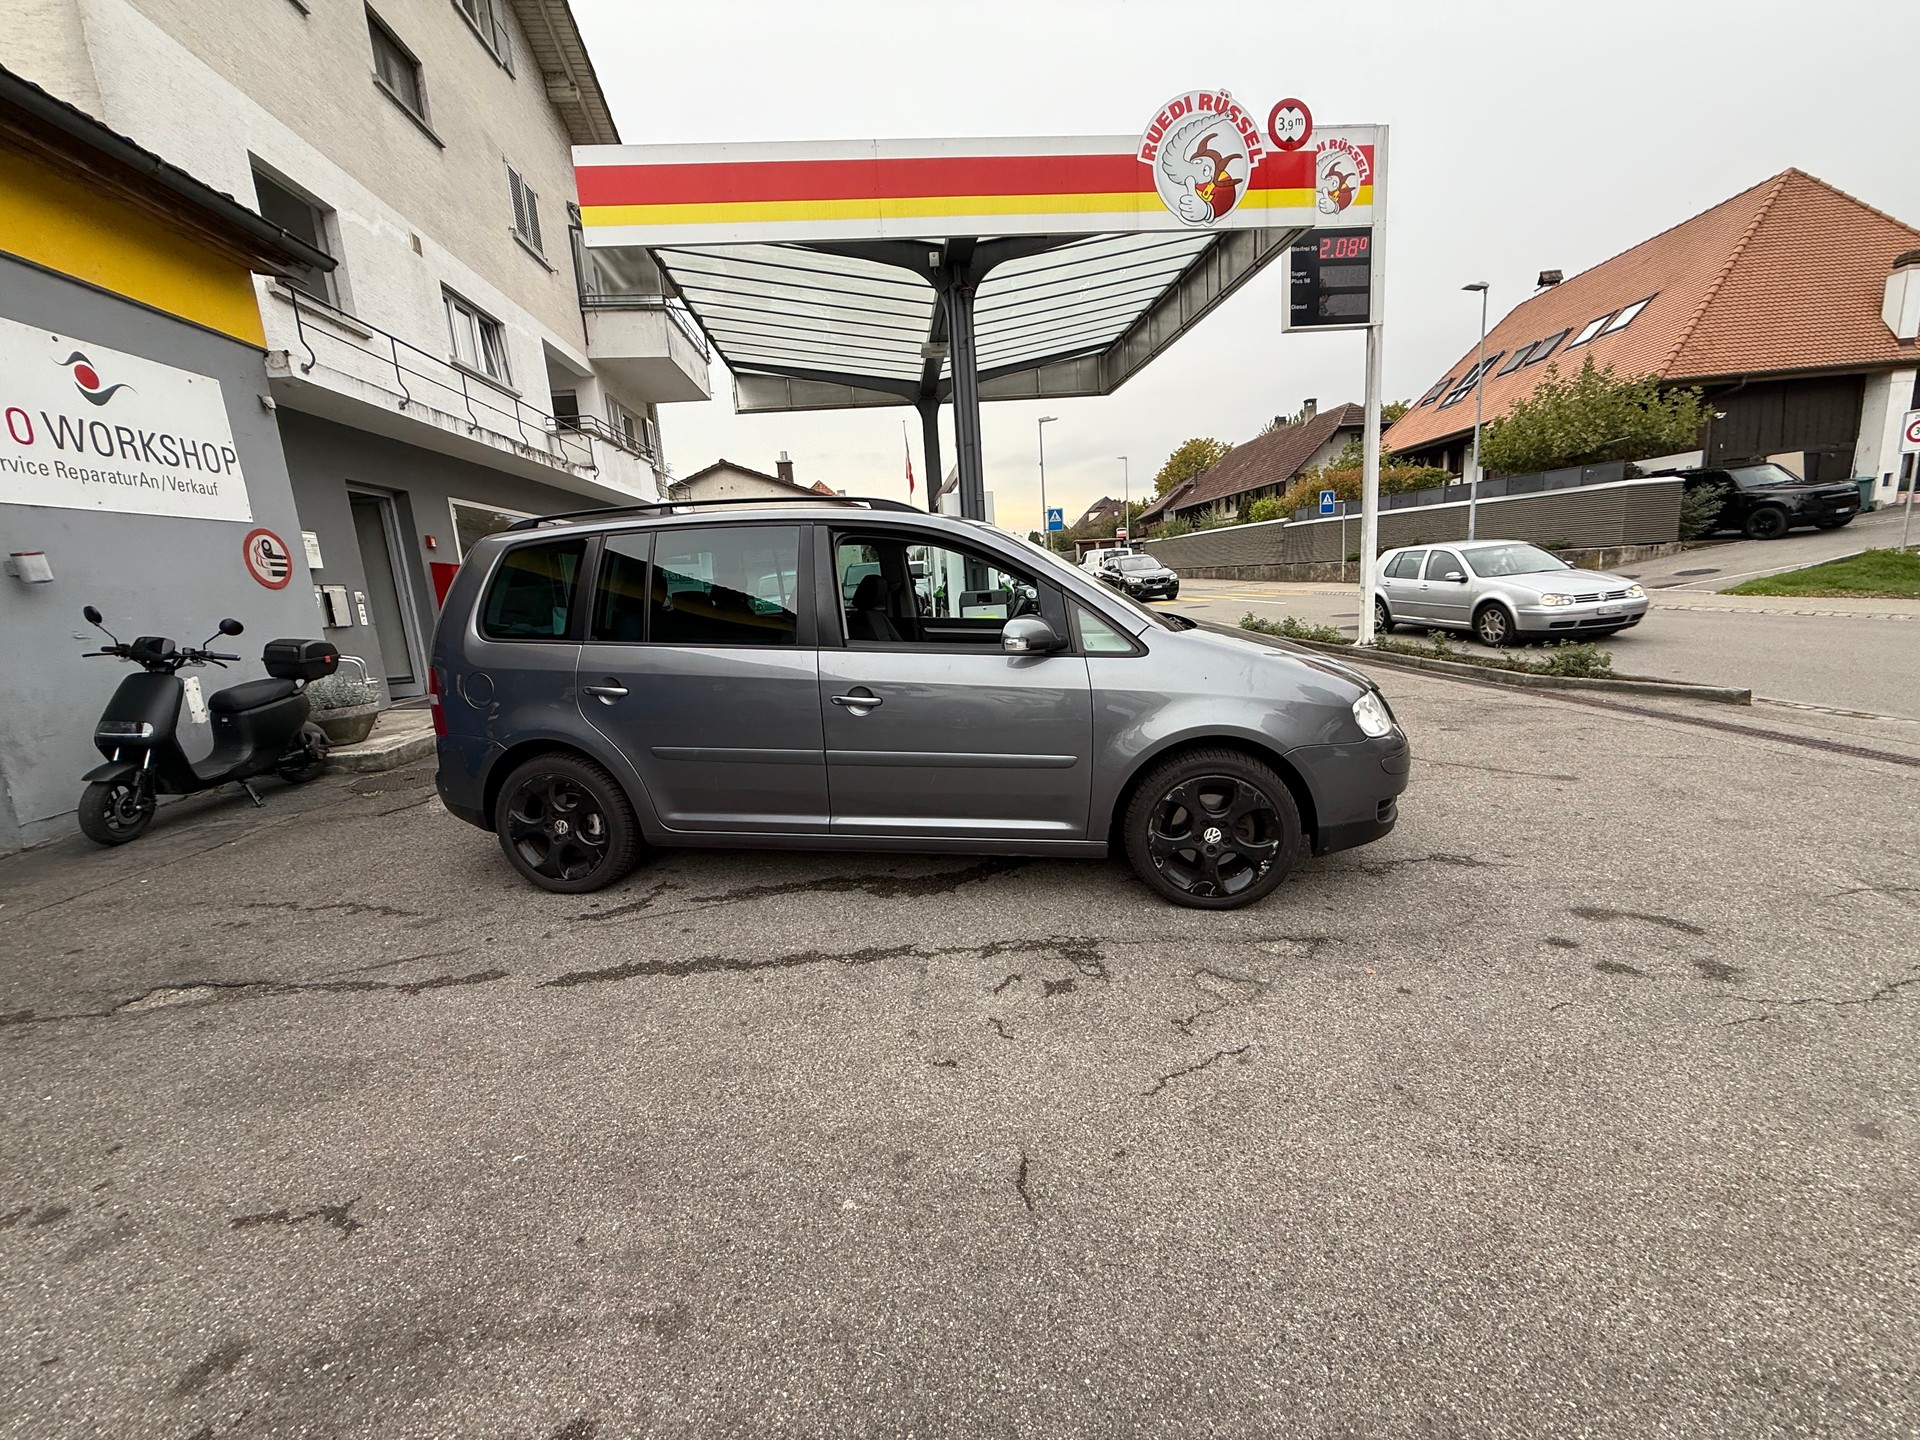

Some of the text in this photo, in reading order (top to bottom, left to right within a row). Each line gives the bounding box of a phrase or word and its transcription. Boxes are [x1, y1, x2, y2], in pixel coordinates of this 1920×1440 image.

[1141, 91, 1263, 164] RUEDI RÜSSEL
[1278, 117, 1304, 132] 3,9 m
[1329, 137, 1367, 179] RÜSSEL
[1291, 270, 1307, 278] Super
[40, 411, 236, 475] WORKSHOP
